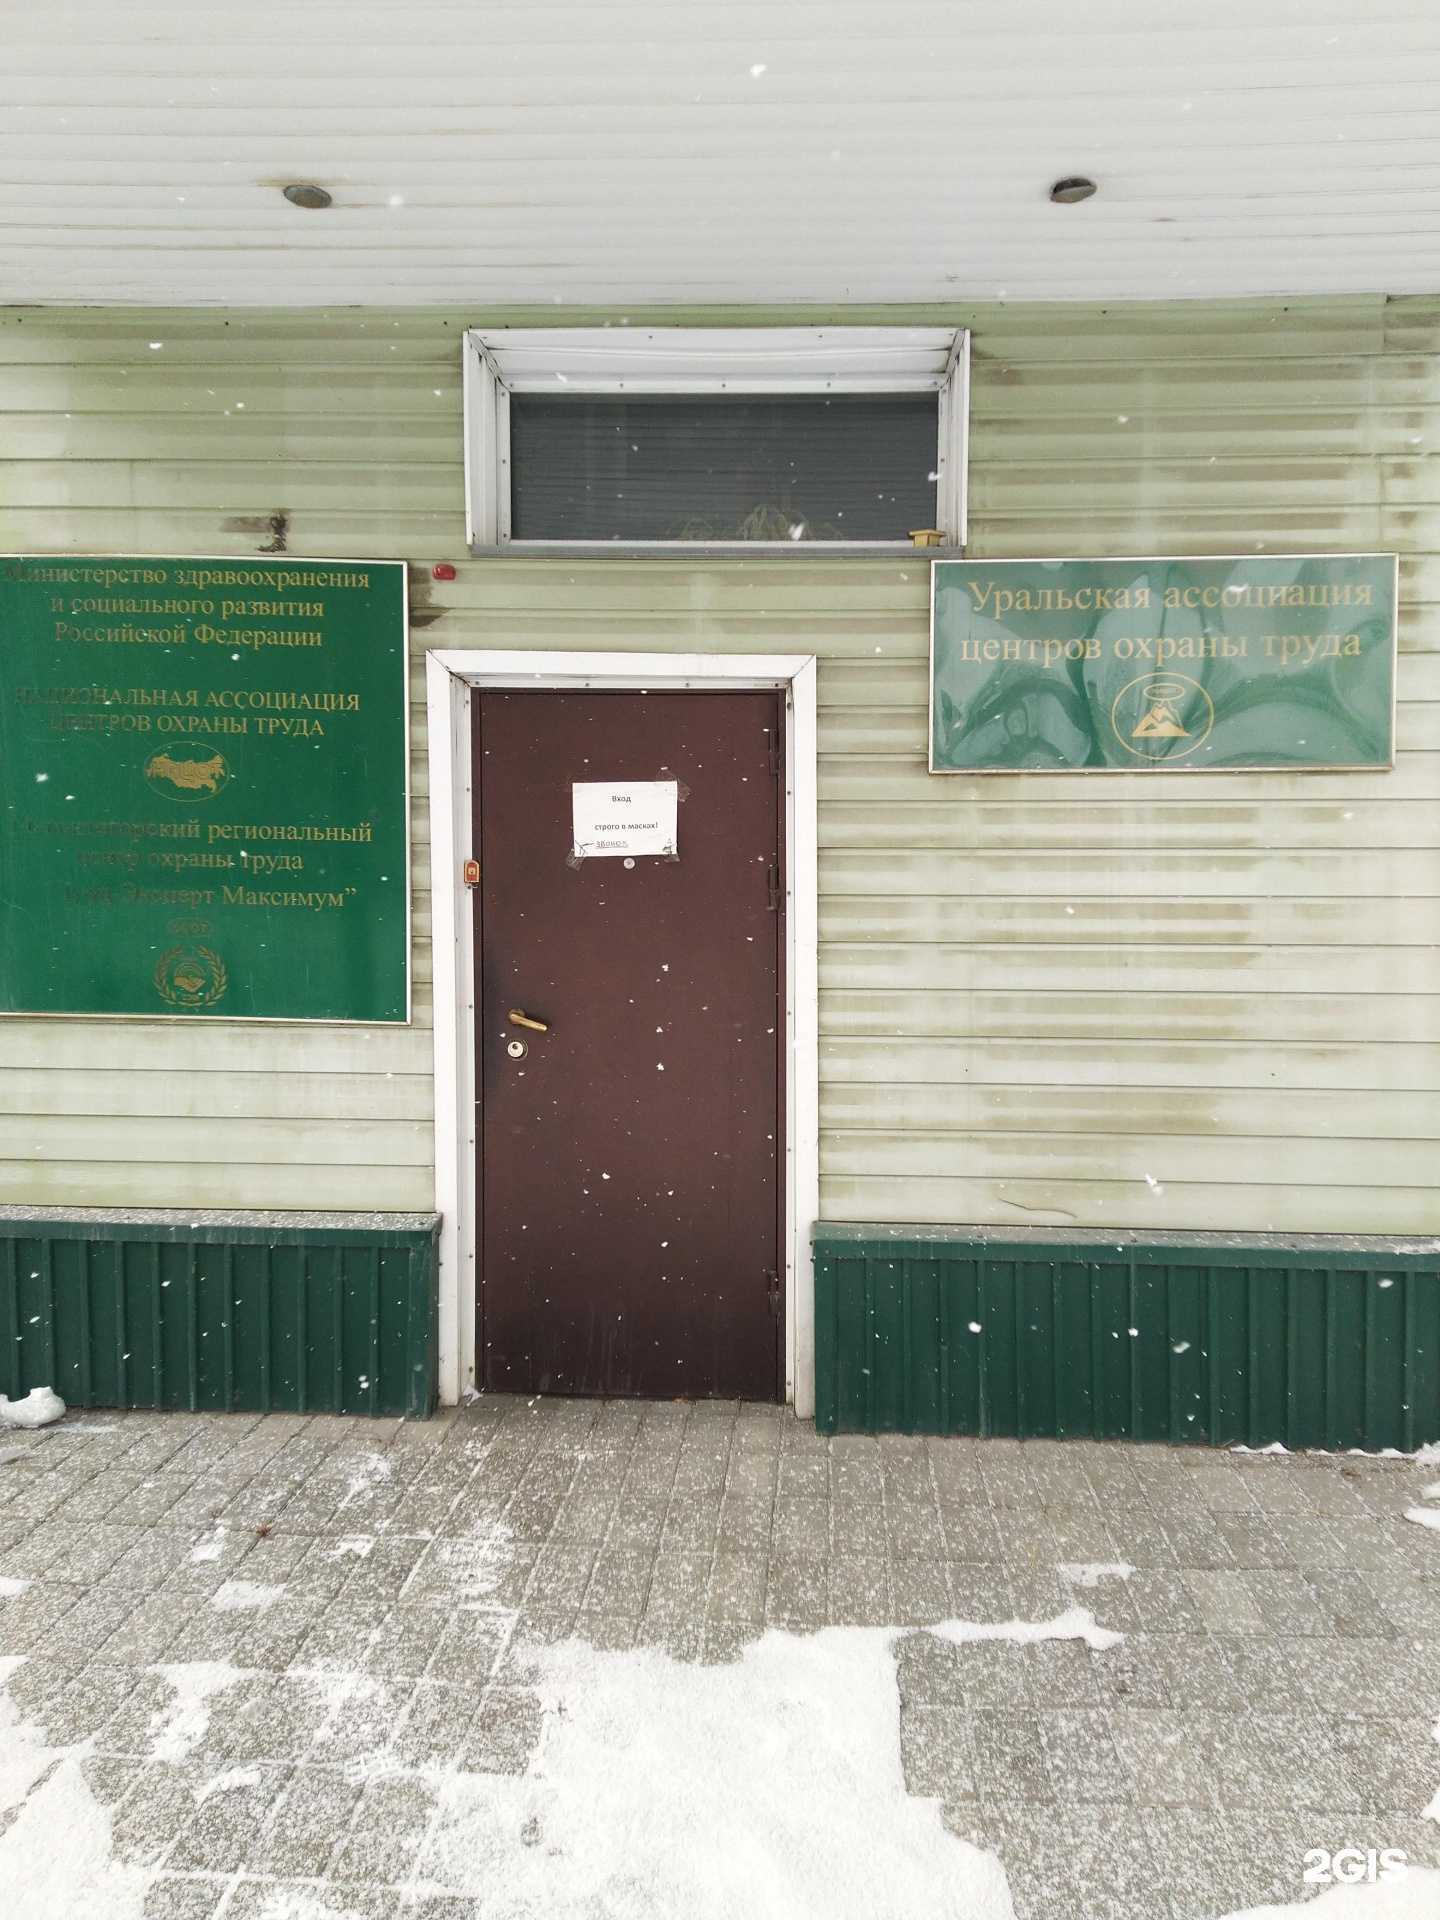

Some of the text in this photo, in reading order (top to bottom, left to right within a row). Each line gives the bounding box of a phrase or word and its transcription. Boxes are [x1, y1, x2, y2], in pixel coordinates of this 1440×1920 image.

[174, 568, 370, 592] здравоохранения
[51, 598, 325, 620] и социального развития
[967, 580, 1375, 619] Уральская ассоциация
[55, 621, 323, 650] Российской Федерации
[960, 631, 1362, 667] центров охраны труда
[205, 690, 361, 712] АССОЦИАЦИЯ
[50, 713, 325, 737] ЕНТРОВ ОХРАНЫ ТРУДА
[611, 795, 632, 803] Вход
[208, 822, 373, 844] региональный
[627, 821, 658, 830] масках!
[241, 853, 304, 875] труда
